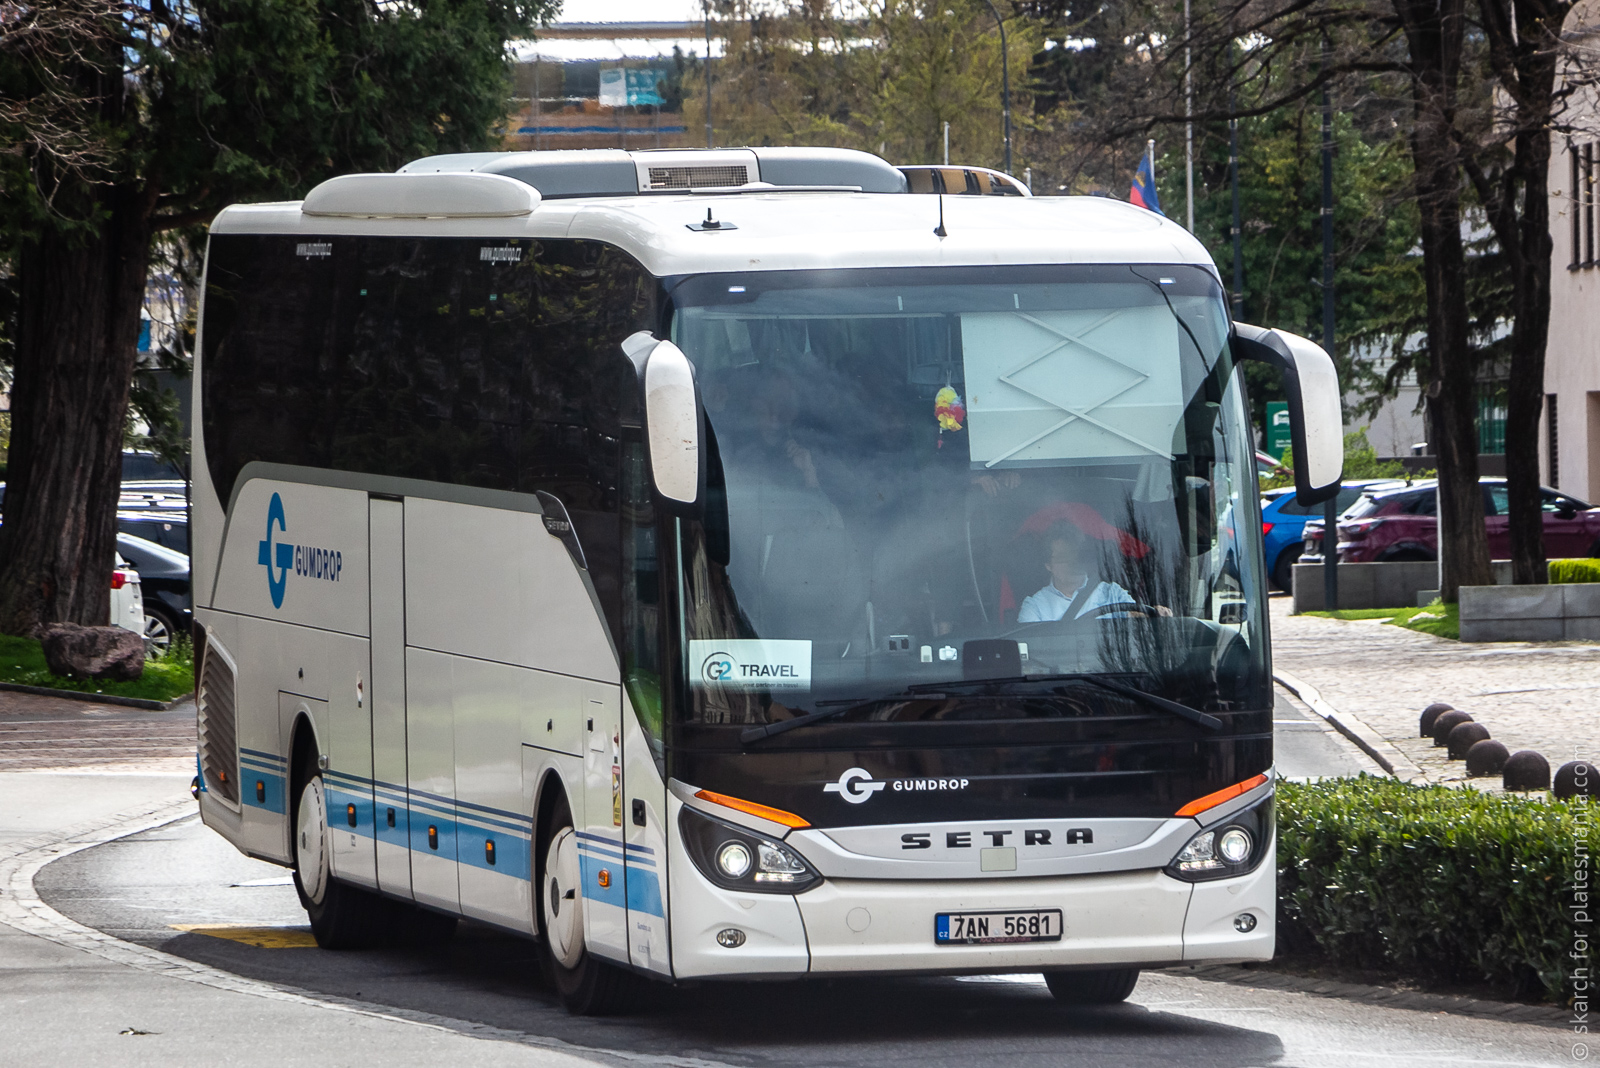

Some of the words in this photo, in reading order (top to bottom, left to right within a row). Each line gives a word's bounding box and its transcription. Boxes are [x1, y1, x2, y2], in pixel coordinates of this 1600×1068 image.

[295, 545, 343, 582] GUMDROP
[706, 660, 732, 681] G2
[740, 664, 799, 678] TRAVEL
[893, 779, 970, 791] GUMDROP
[901, 828, 1094, 850] SETRA
[954, 916, 989, 938] 7AN
[1004, 915, 1050, 936] 5681
